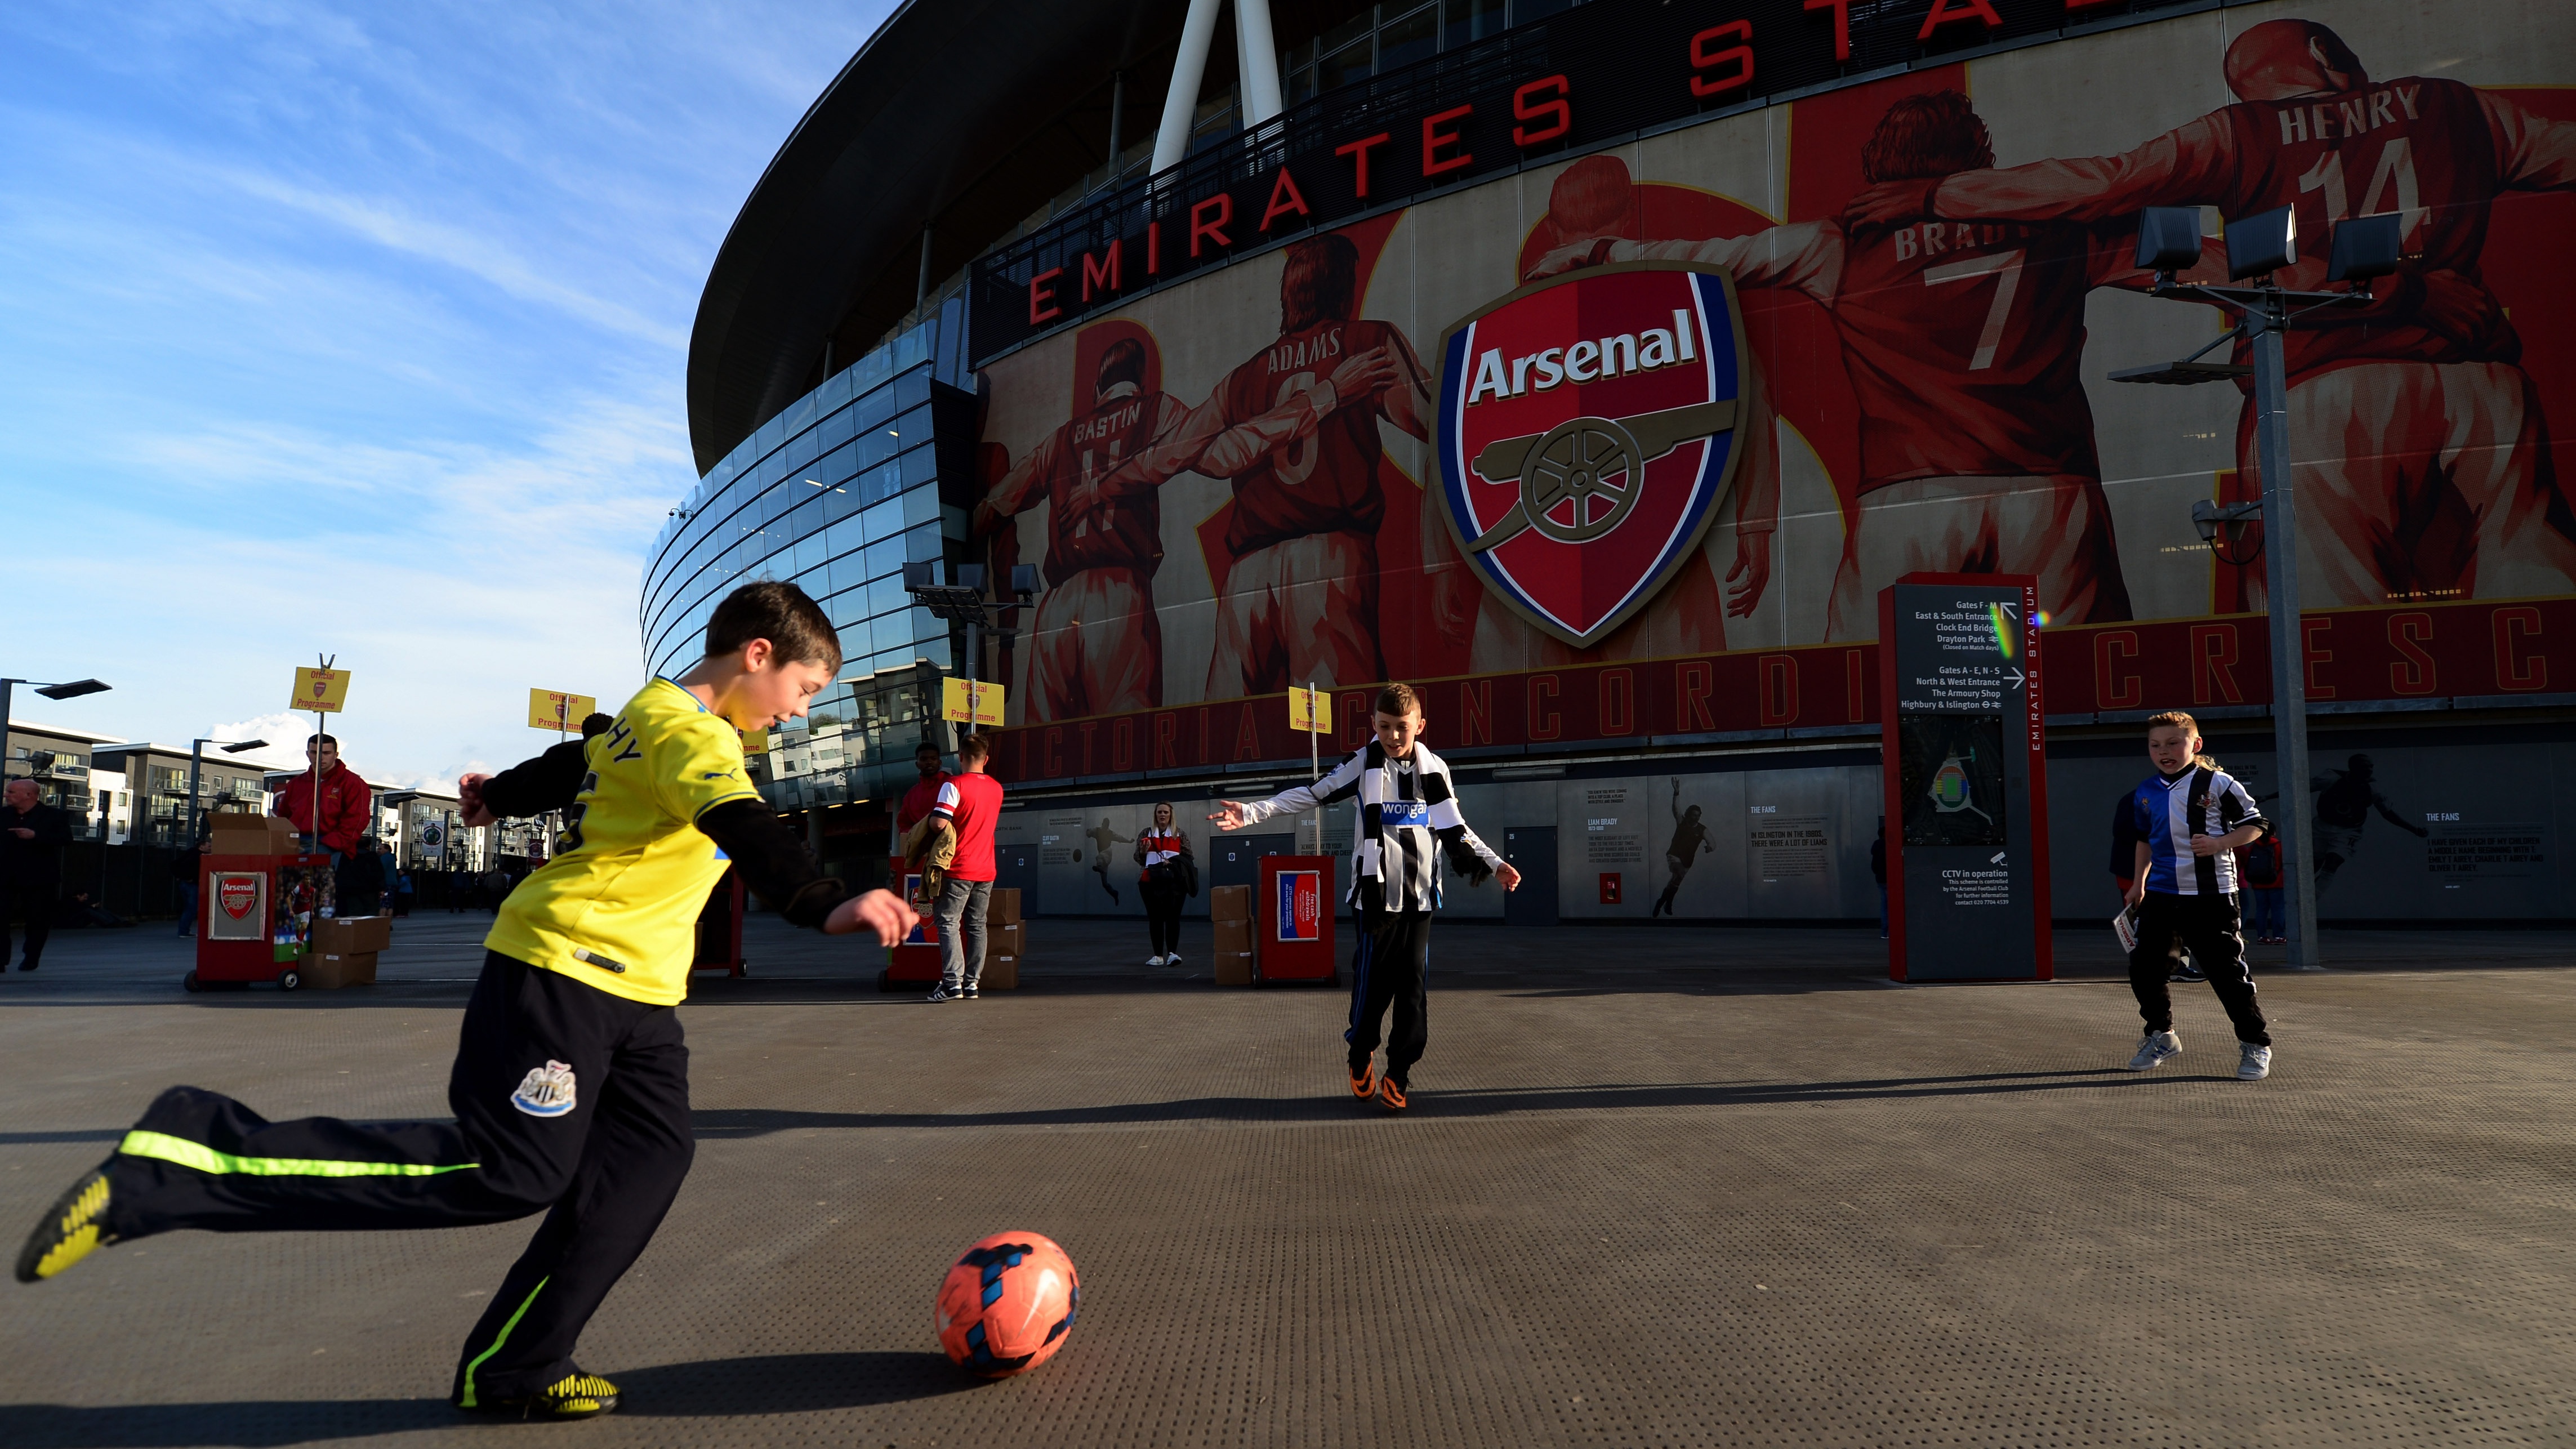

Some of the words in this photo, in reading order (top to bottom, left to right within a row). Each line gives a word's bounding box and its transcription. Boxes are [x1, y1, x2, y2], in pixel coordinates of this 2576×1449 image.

[2279, 84, 2421, 145] HENRY
[1029, 74, 1570, 325] EMIRATES
[1690, 0, 2106, 98] STA
[2299, 137, 2431, 253] 14
[1923, 249, 2026, 371] 7
[1268, 327, 1342, 375] ADAMS
[1466, 309, 1698, 407] Arsenal
[1074, 403, 1141, 444] BASTIN
[1973, 625, 1998, 634] Bridge
[2026, 587, 2037, 657] STADIUM
[1937, 635, 1967, 644] Drayton
[961, 682, 987, 693] Offcial
[1947, 689, 1980, 698] Armoury
[1981, 689, 2000, 699] Shop
[297, 698, 336, 709] Programme
[1340, 649, 1864, 753] CNCORDI
[1901, 701, 1937, 710] Highbury
[1946, 701, 1980, 710] Islington
[2030, 671, 2040, 751] EMIRATES
[538, 718, 582, 730] Progrmm
[951, 709, 995, 721] Progrmme
[2425, 813, 2440, 822] THE
[2440, 813, 2460, 821] FANS
[1972, 869, 2008, 879] operation
